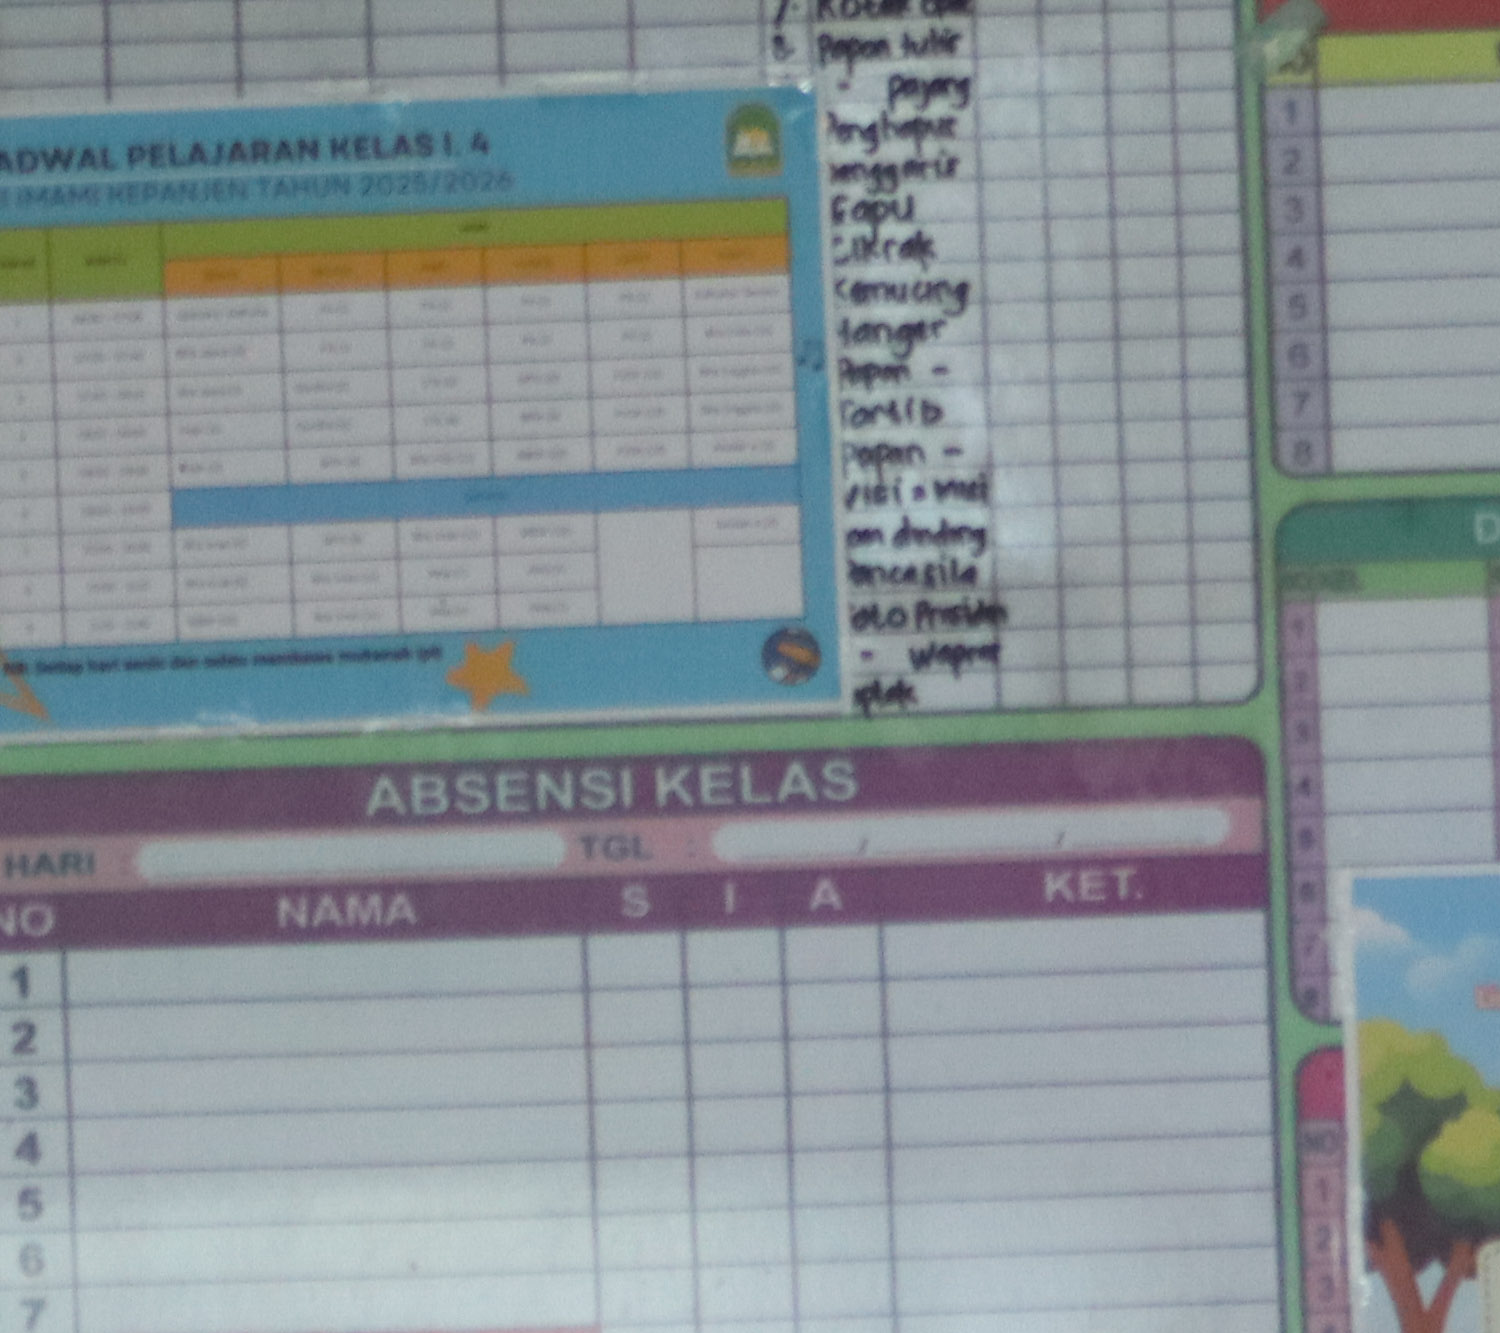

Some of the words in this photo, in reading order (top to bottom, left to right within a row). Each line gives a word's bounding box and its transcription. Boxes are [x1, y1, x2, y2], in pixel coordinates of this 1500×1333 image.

[128, 139, 320, 170] PELAJARAN
[330, 133, 434, 162] KELAS
[260, 174, 351, 199] TAHUN
[365, 764, 633, 818] ABSENSI
[654, 759, 862, 810] KELAS
[3, 847, 97, 881] HARI
[579, 833, 654, 862] TGL
[0, 903, 56, 938] NO
[276, 893, 419, 930] NAMA
[621, 883, 651, 919] S
[724, 880, 738, 915] I
[809, 877, 845, 914] A
[1043, 867, 1145, 905] KET.
[10, 964, 31, 1000] 1
[11, 1020, 39, 1057] 2
[13, 1074, 41, 1112] 3
[13, 1129, 44, 1167] 4
[17, 1185, 44, 1223] 5
[18, 1241, 46, 1279] 6
[18, 1296, 48, 1333] 7
